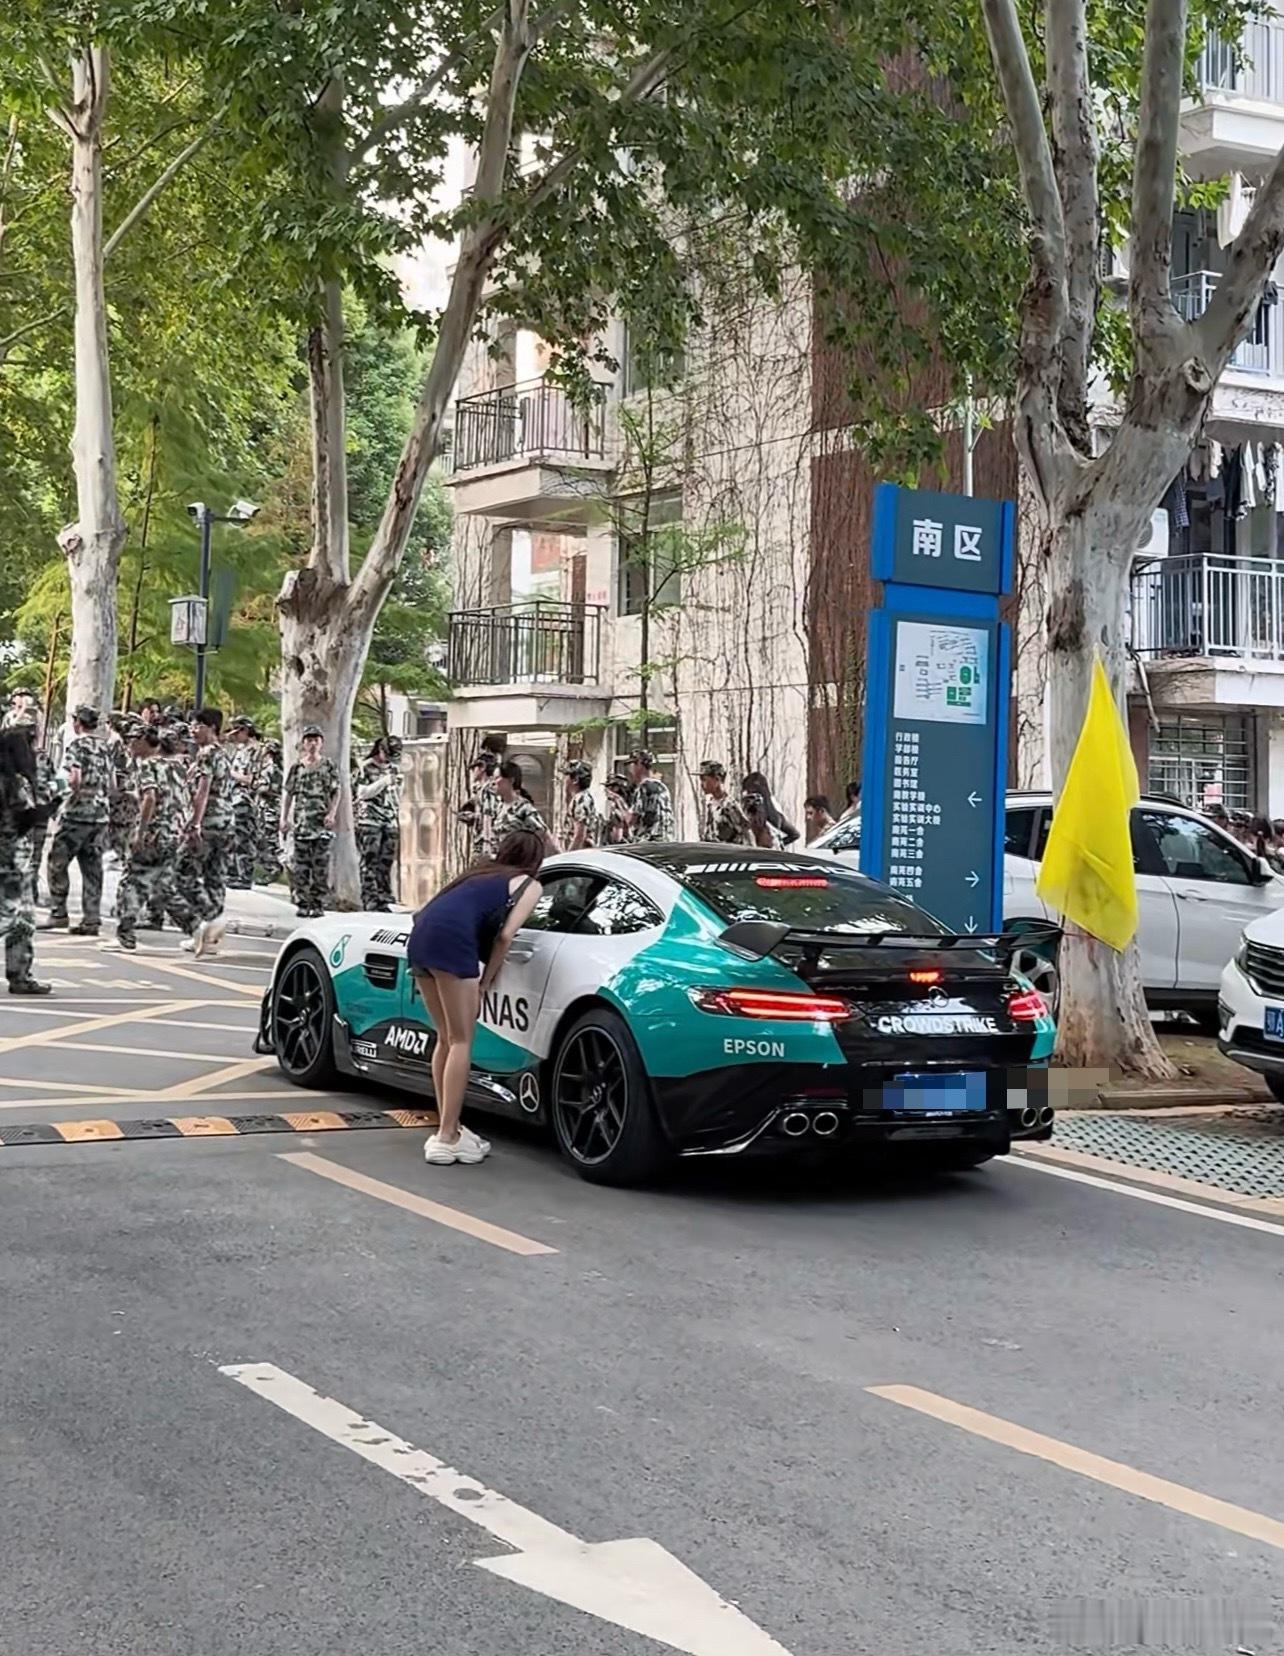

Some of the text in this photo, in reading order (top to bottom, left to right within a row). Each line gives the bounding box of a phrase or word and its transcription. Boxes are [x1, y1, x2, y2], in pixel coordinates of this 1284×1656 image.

[912, 518, 983, 562] 南区
[893, 777, 918, 789] 图书馆
[876, 1014, 1000, 1034] CROWDSTRIKE
[384, 1024, 419, 1052] AMD
[723, 1038, 786, 1058] EPSON
